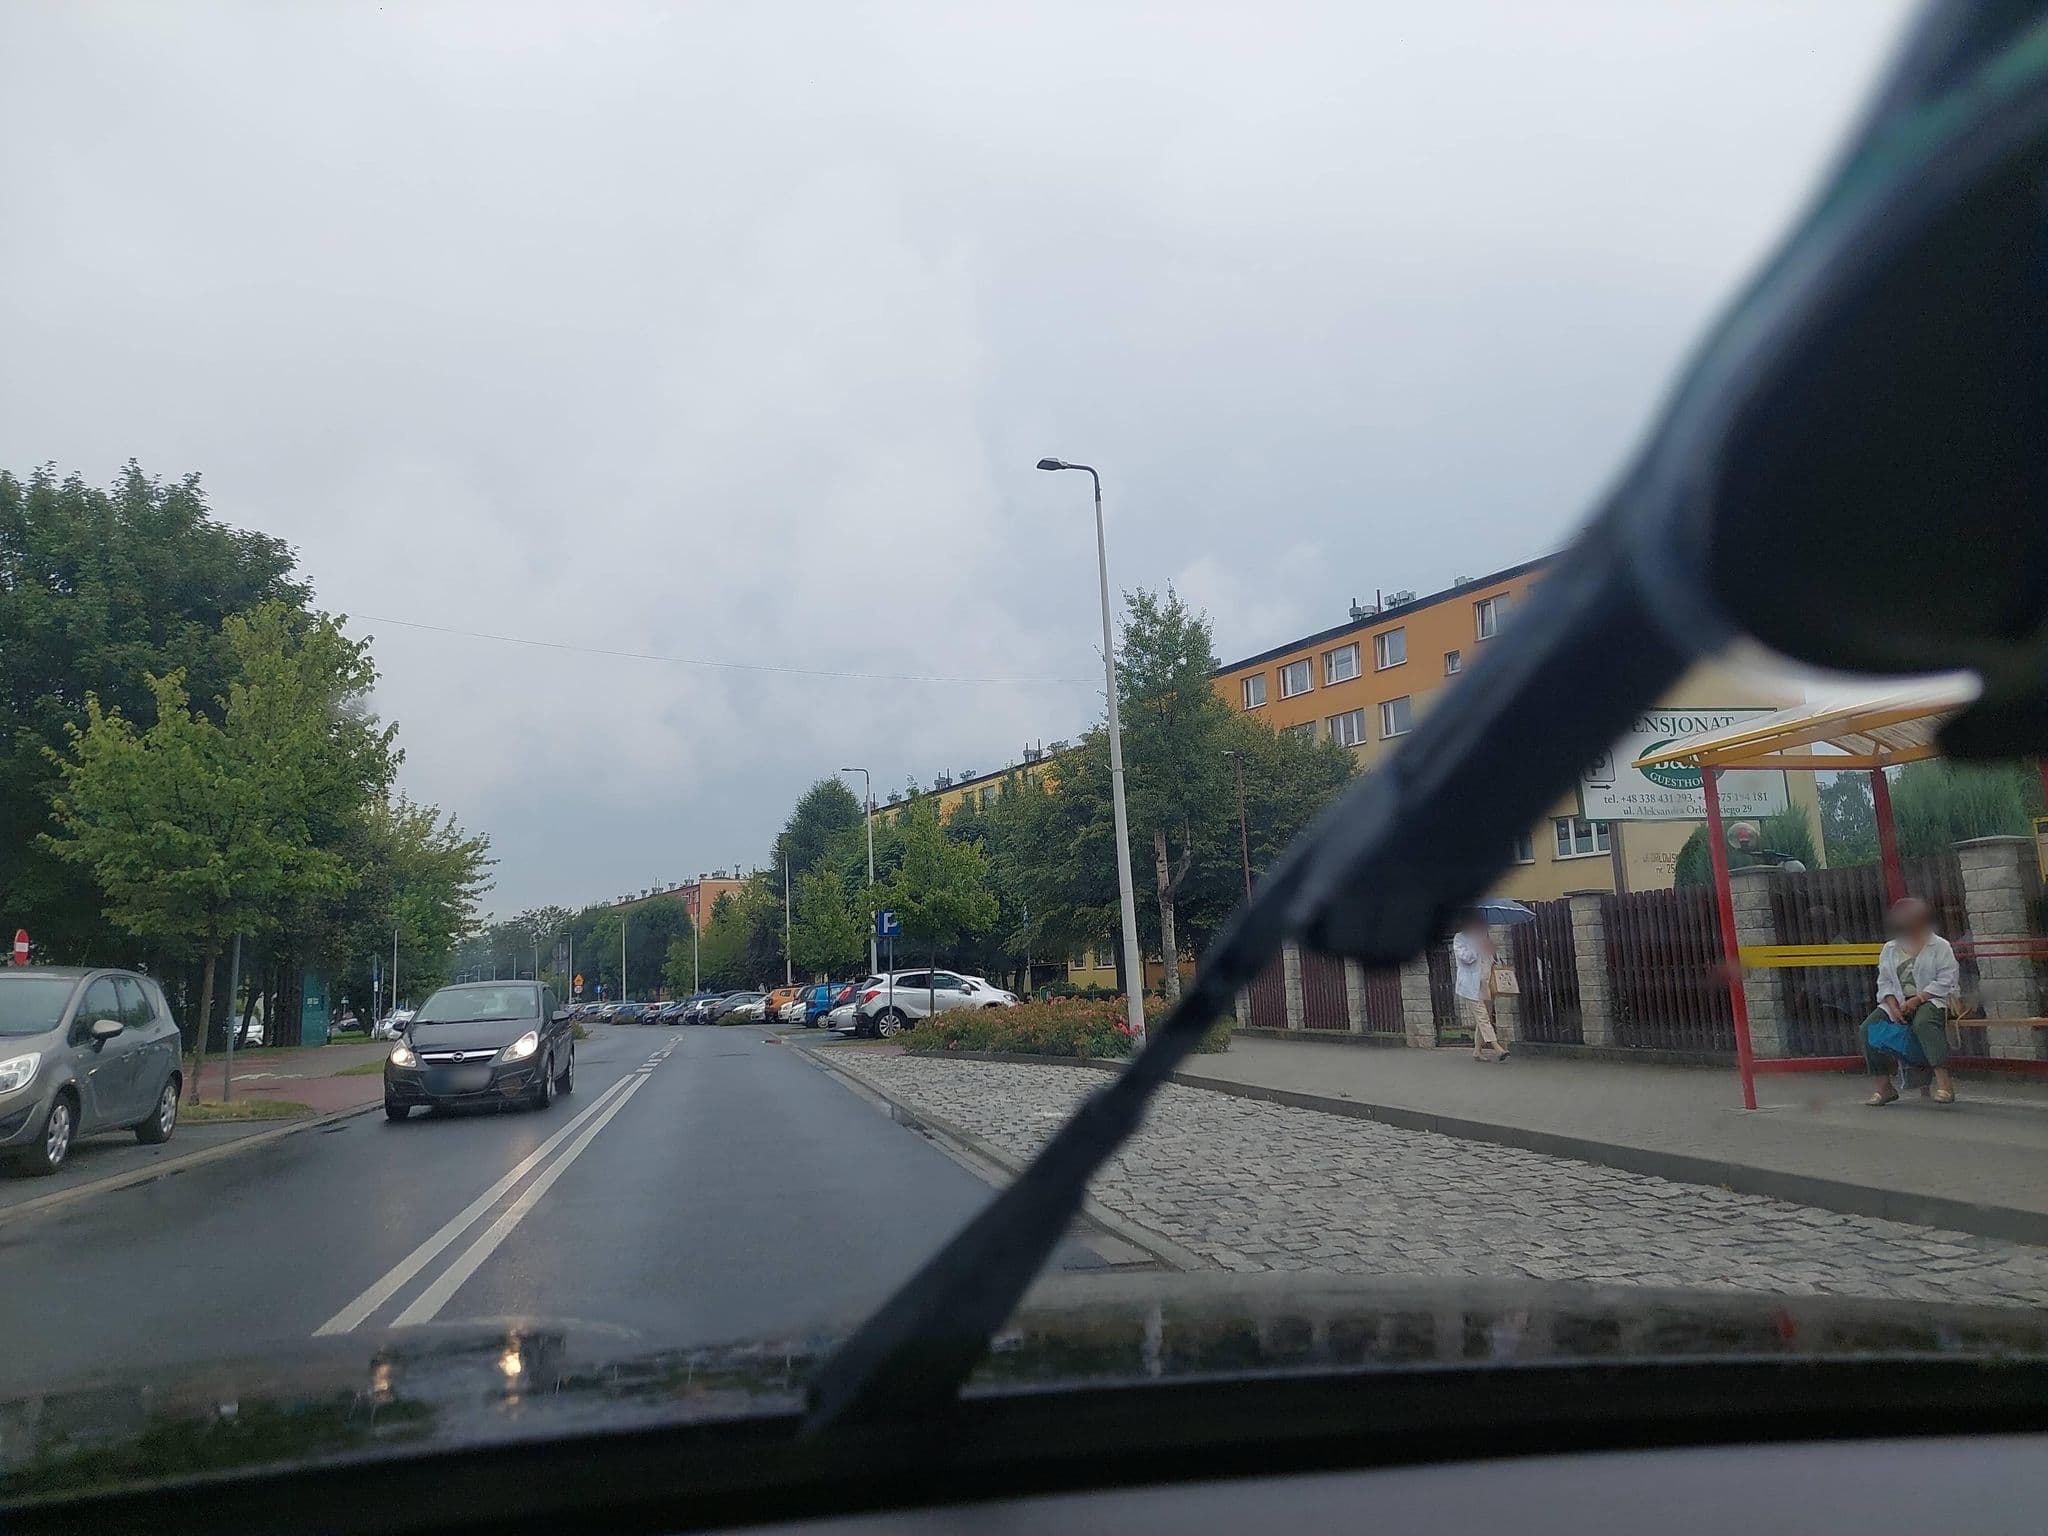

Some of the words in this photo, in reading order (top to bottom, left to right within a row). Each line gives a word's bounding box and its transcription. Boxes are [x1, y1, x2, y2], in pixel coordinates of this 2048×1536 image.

[1632, 716, 1735, 737] ENSJONAT
[1604, 794, 1619, 804] tel.
[1621, 794, 1638, 804] +48
[1640, 793, 1656, 803] 338
[1752, 791, 1768, 801] 181
[1623, 806, 1635, 816] ul.
[1742, 804, 1753, 813] 29
